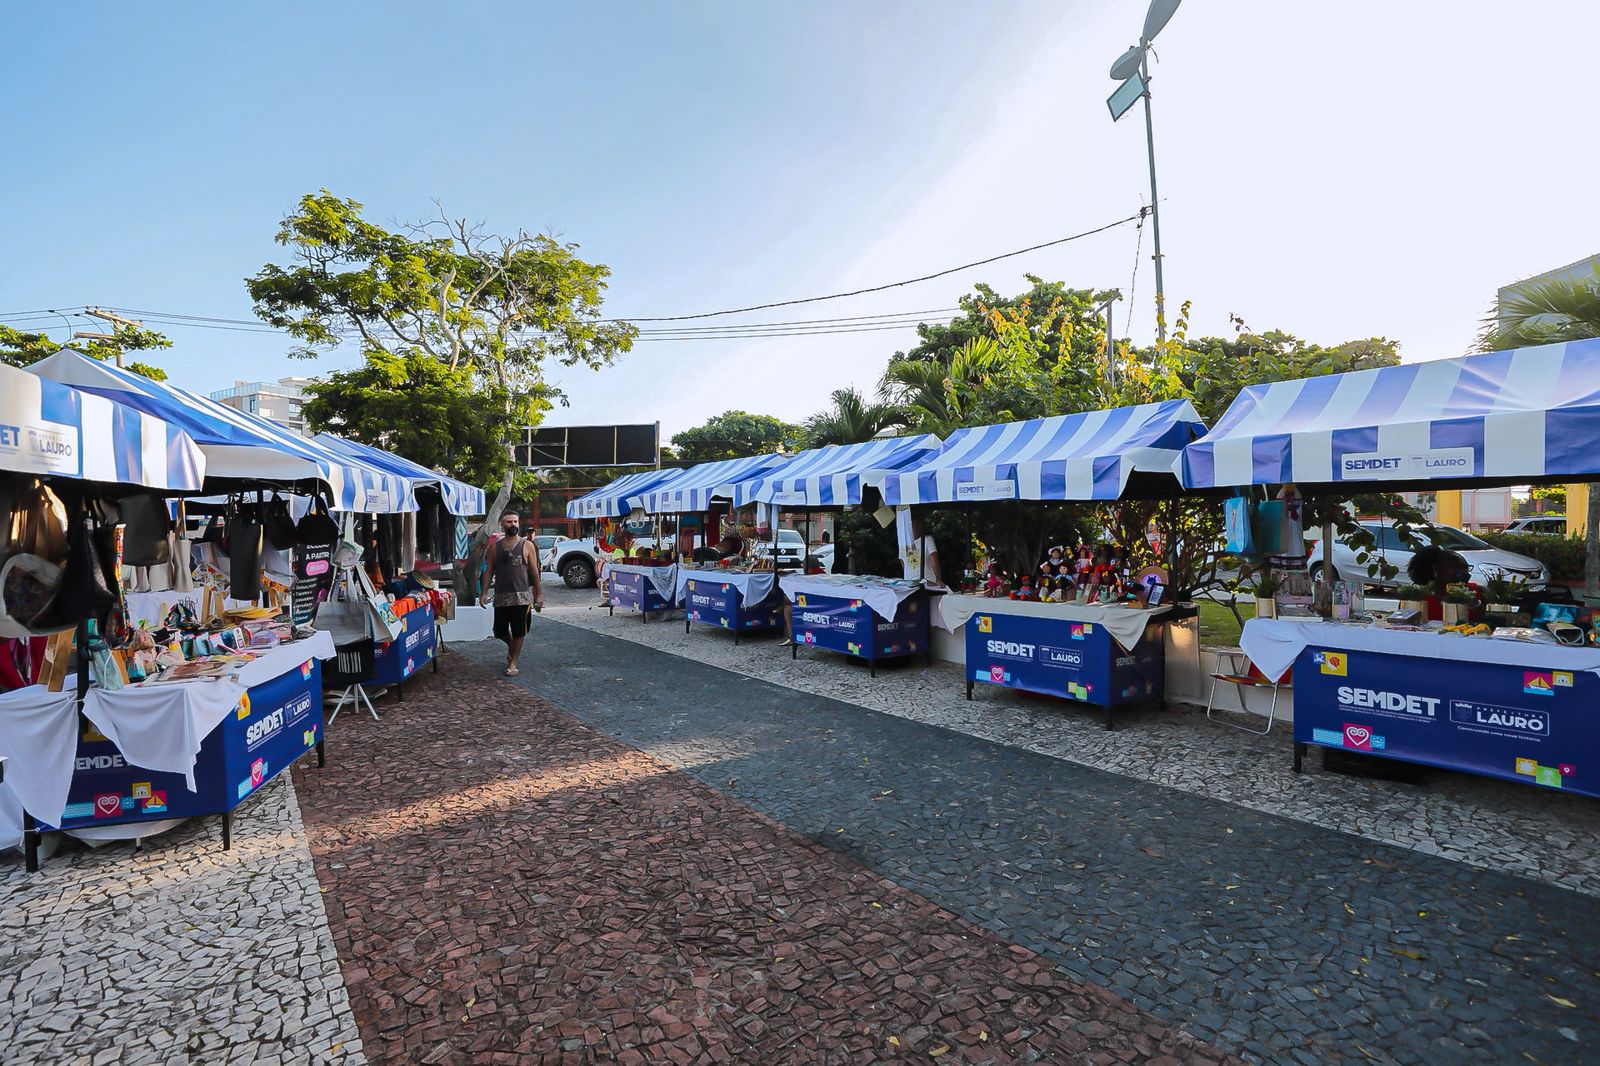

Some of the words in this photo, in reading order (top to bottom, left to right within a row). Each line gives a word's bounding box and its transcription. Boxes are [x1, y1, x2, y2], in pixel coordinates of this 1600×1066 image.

[39, 439, 72, 457] LAURO
[1344, 457, 1401, 470] SEMDET
[1425, 458, 1467, 468] LAURO
[958, 485, 985, 494] SEMDET
[802, 611, 831, 626] SEMDET
[838, 620, 856, 630] LAURO
[986, 639, 1036, 658] SEMDET
[1050, 651, 1081, 664] LAURO
[1337, 686, 1441, 717] SEMDET
[246, 707, 284, 746] SEMDET
[292, 698, 310, 716] LAURO
[1476, 710, 1544, 731] LAURO
[74, 754, 132, 771] EMDE
